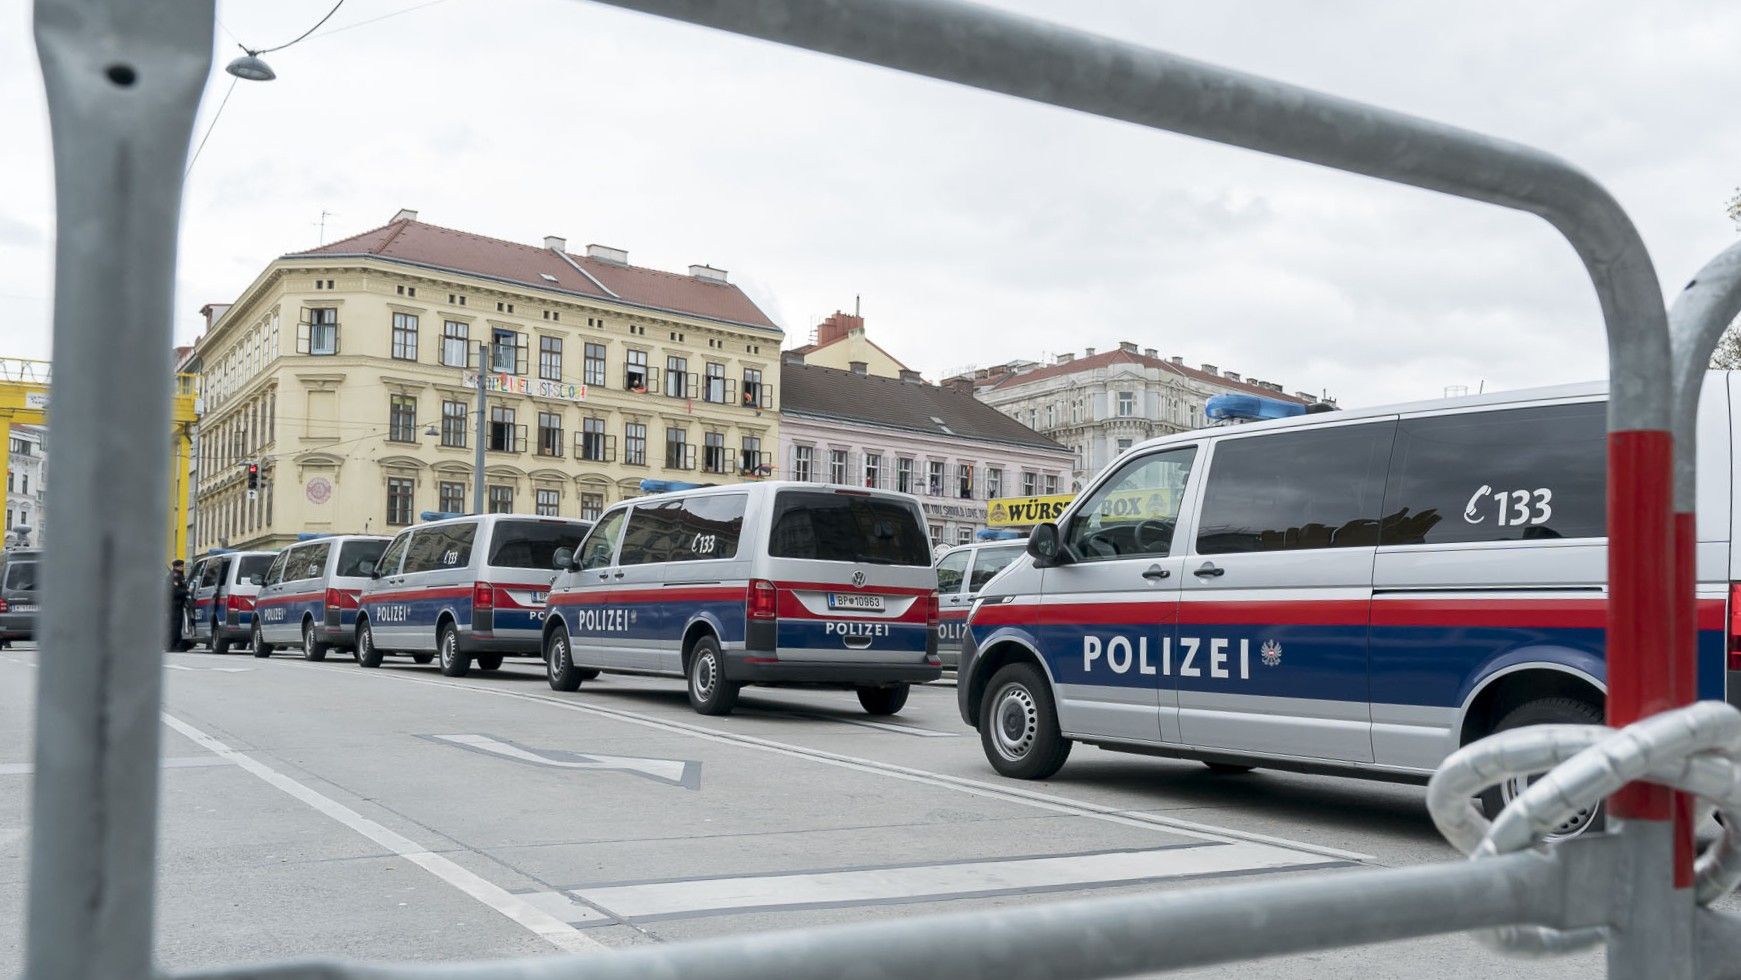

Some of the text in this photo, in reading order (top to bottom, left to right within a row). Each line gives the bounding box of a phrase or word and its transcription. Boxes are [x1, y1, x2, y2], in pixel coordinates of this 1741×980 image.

[1101, 497, 1142, 516] BOX
[1494, 488, 1552, 526] 133
[699, 535, 715, 553] 133
[264, 608, 284, 621] POLIZEI
[377, 606, 407, 622] POLIZEI
[579, 609, 628, 631] POLIZEI
[826, 622, 889, 636] POLIZEI
[938, 623, 968, 639] OLIZ
[1084, 635, 1249, 680] POLIZEI
